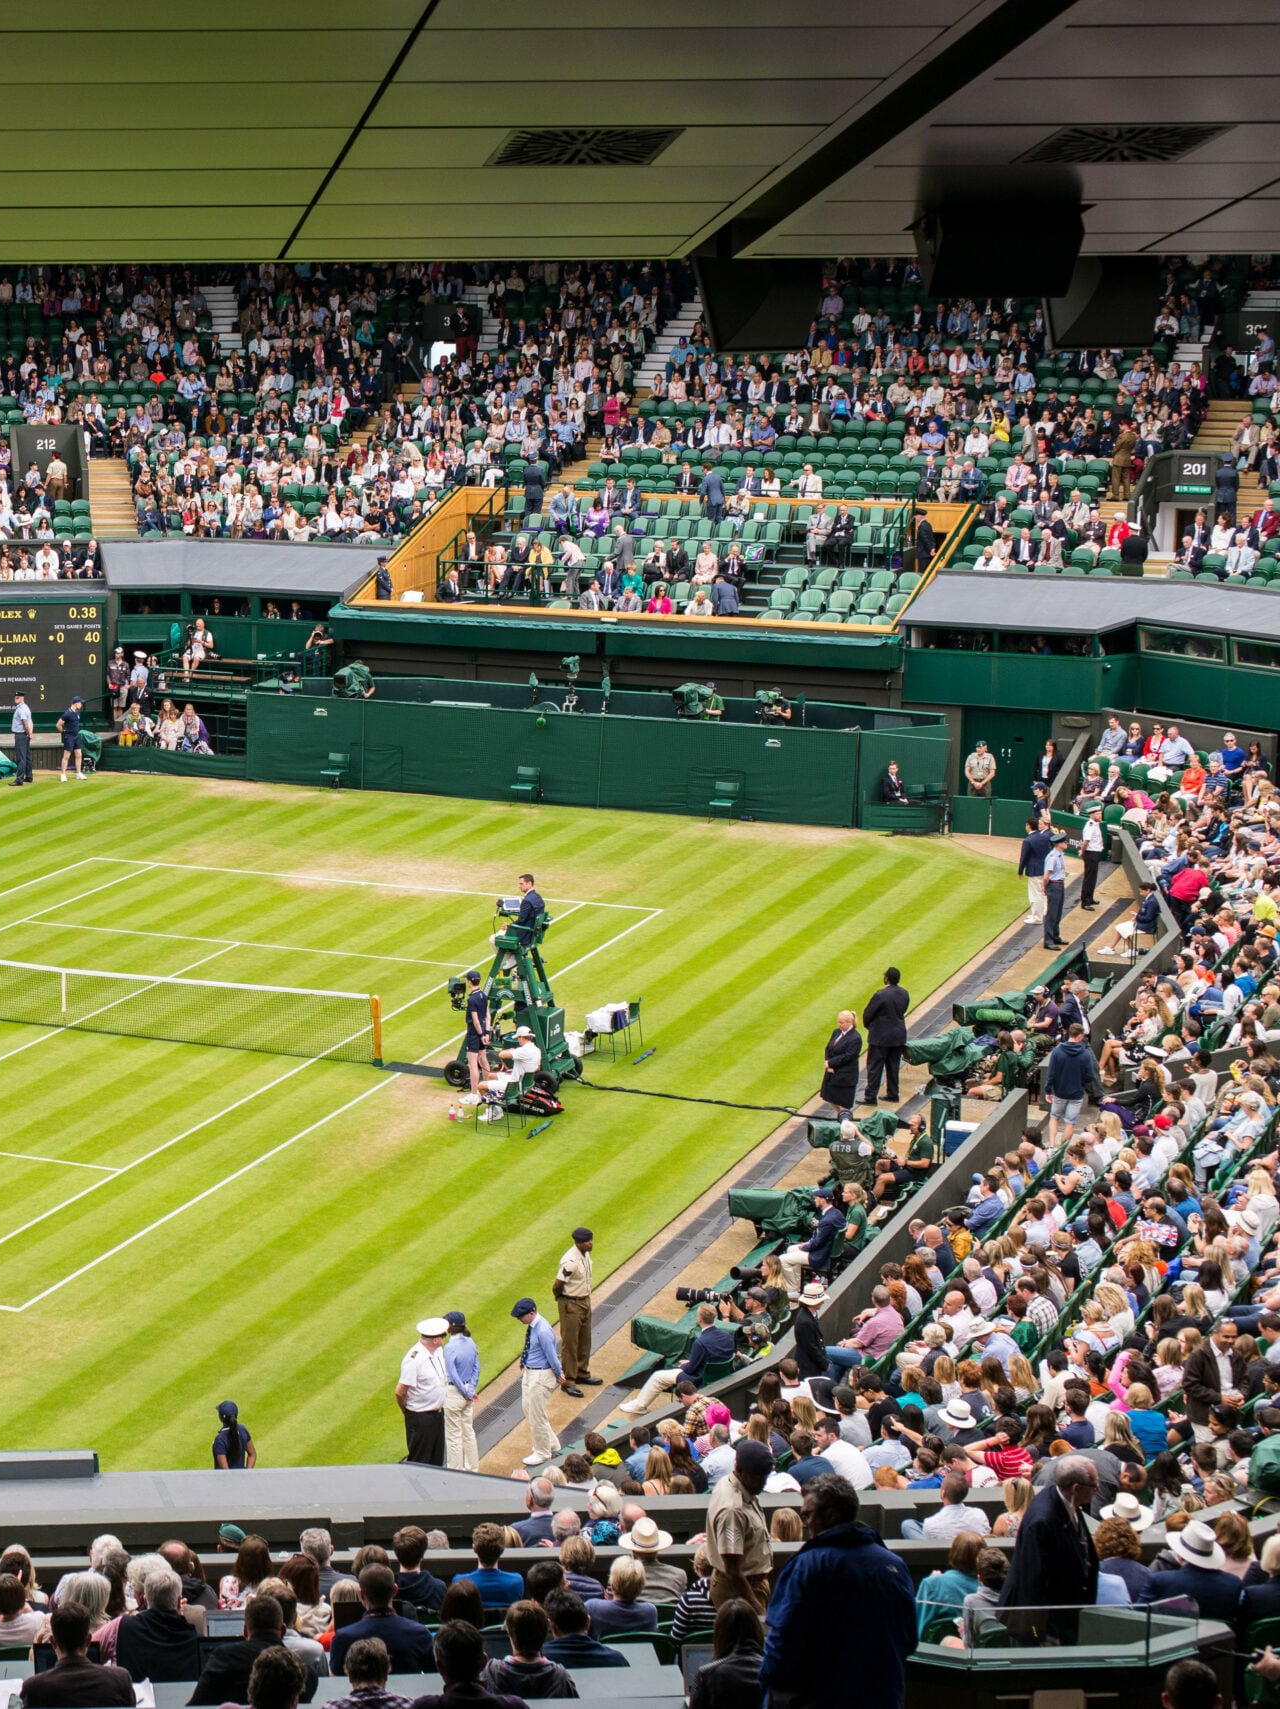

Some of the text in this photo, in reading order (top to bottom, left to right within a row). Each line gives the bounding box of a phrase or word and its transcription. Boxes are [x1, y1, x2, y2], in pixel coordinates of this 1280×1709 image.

[36, 439, 56, 450] 212
[1182, 463, 1207, 475] 201
[69, 607, 97, 619] 0.38
[56, 632, 65, 643] 0
[84, 632, 100, 643] 40
[58, 654, 65, 666] 1
[88, 654, 97, 665] 0
